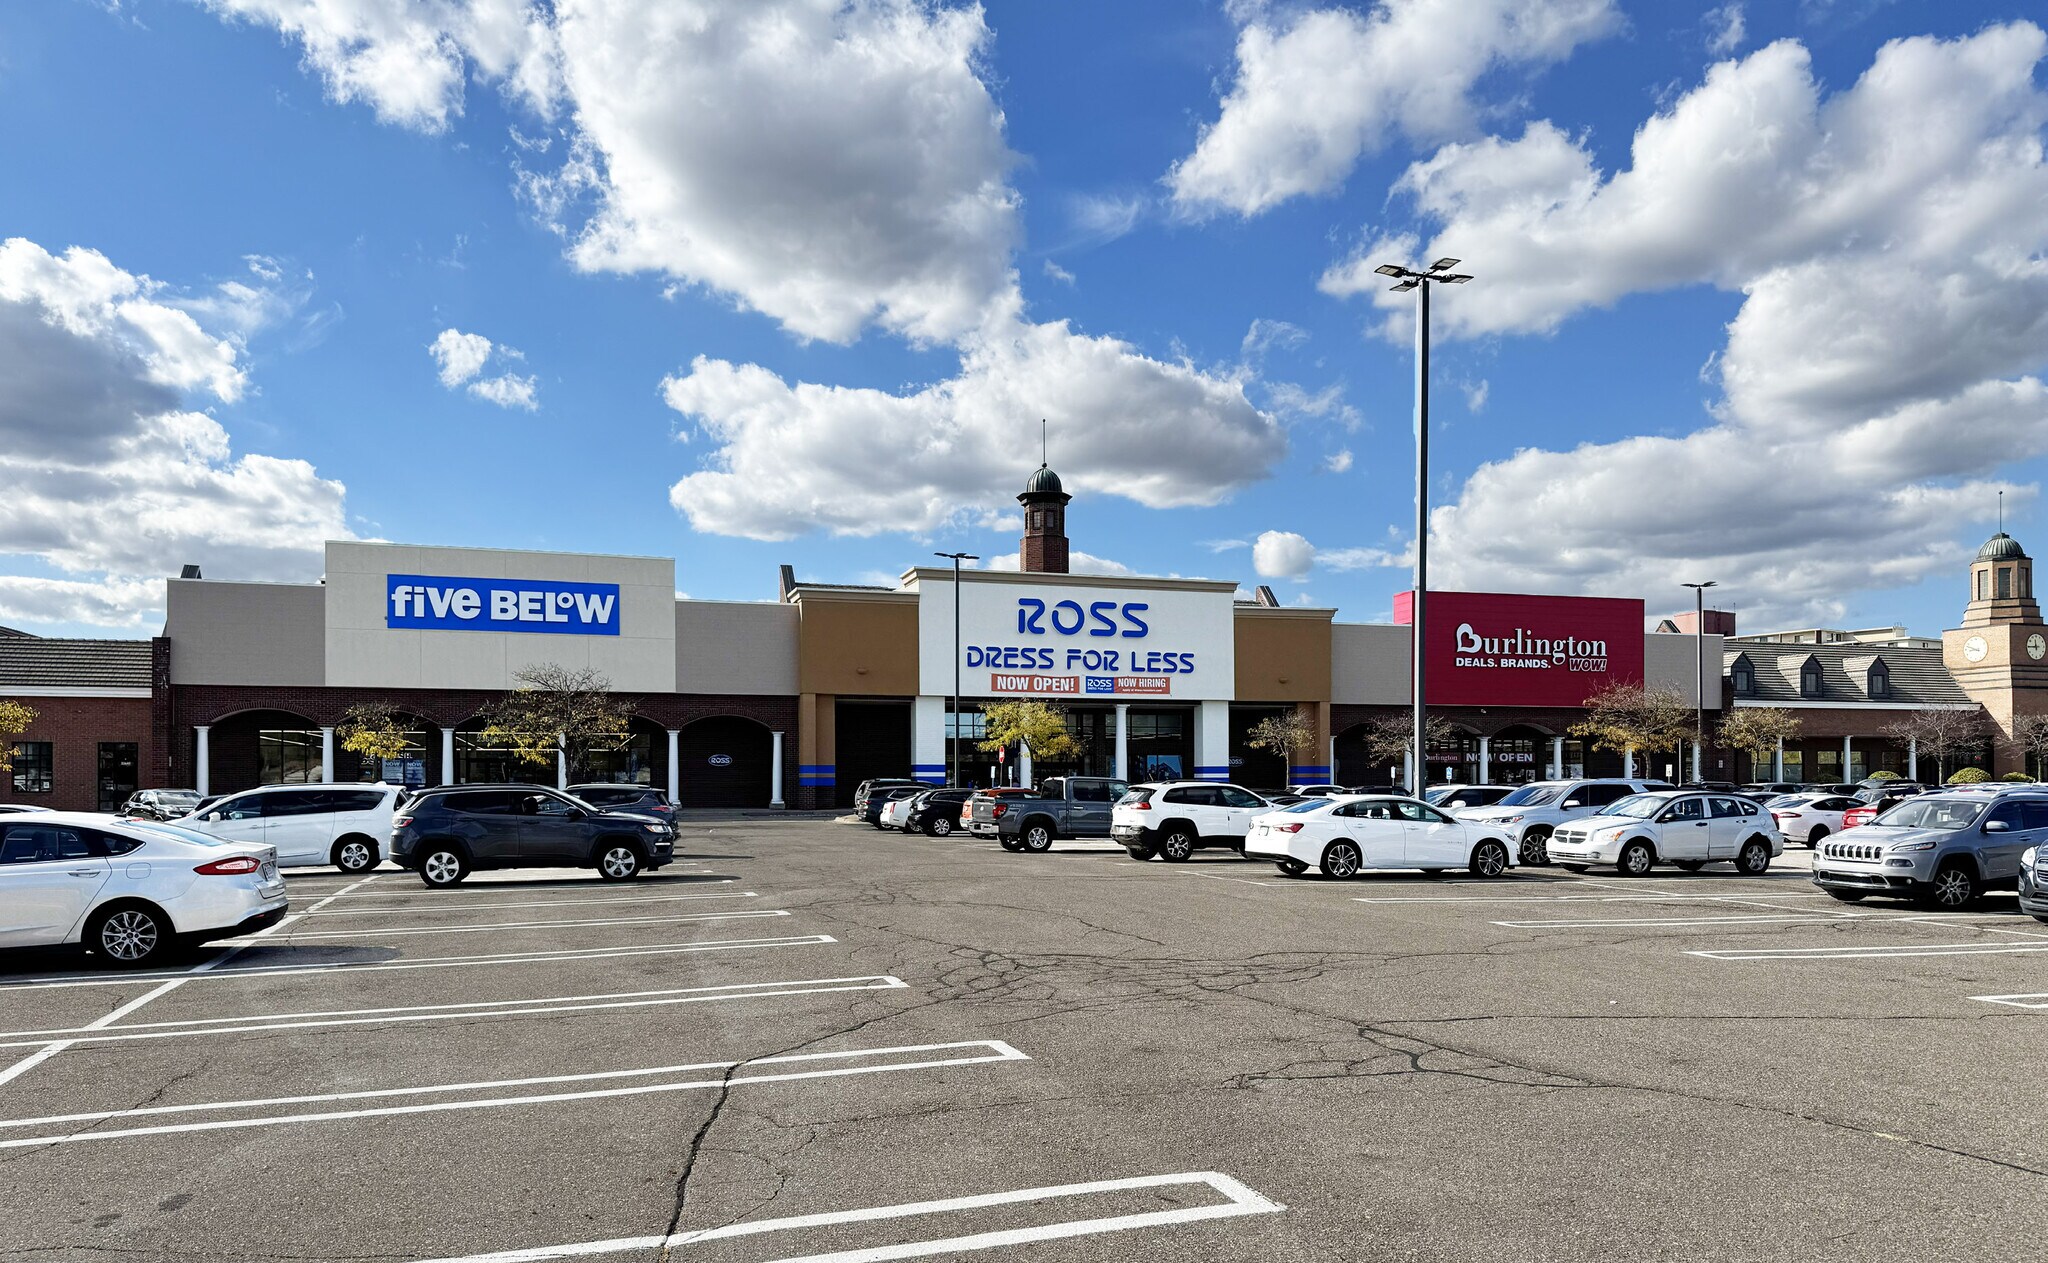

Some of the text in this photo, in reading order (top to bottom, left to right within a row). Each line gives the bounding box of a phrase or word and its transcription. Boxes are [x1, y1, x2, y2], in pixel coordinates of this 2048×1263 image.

[391, 585, 481, 619] five
[1018, 597, 1149, 638] ROSS
[1455, 622, 1608, 665] Burlington
[966, 645, 1195, 674] DRESS FOR LESS
[1456, 657, 1608, 672] DEALS. BRANDS. WOW!
[997, 676, 1075, 692] NOW OPEN!
[1087, 678, 1112, 687] ROSS
[1118, 677, 1166, 688] NOW HIRING
[1499, 753, 1533, 762] OPEN
